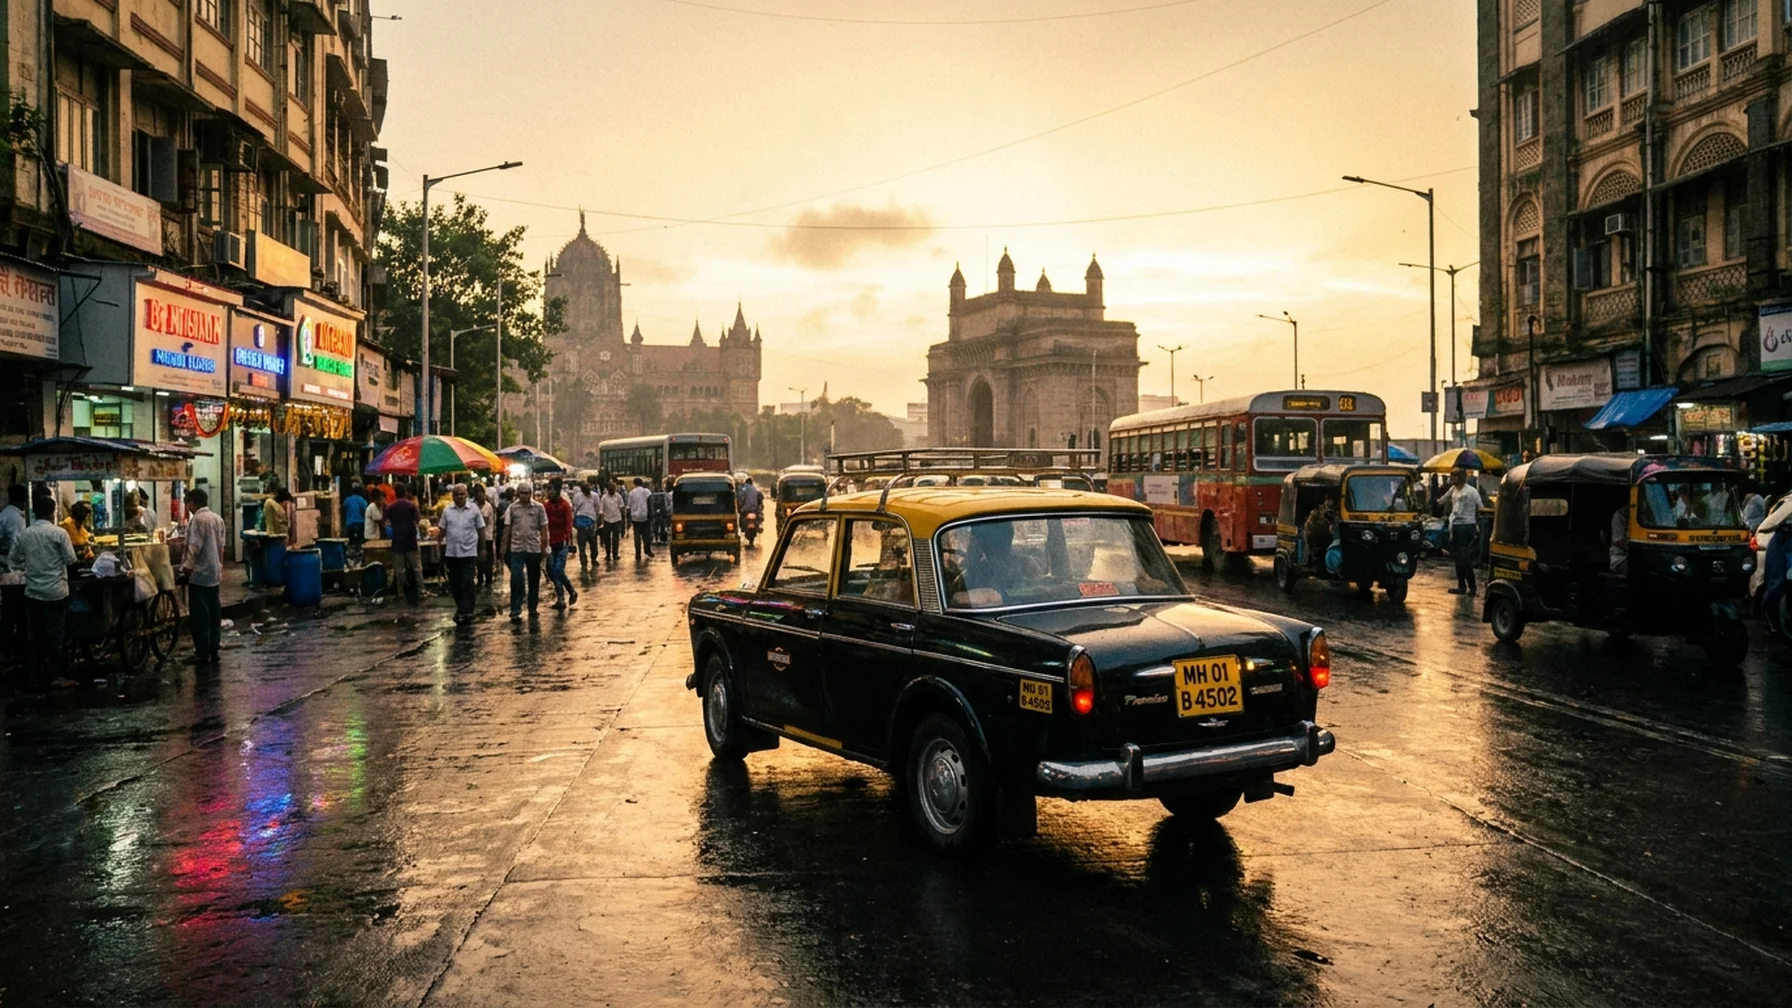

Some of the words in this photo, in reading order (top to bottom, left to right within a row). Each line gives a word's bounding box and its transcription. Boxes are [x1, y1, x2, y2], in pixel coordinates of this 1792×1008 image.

[1183, 664, 1208, 685] MH
[1211, 663, 1229, 682] 01
[1181, 690, 1193, 711] B
[1195, 686, 1238, 709] 4502
